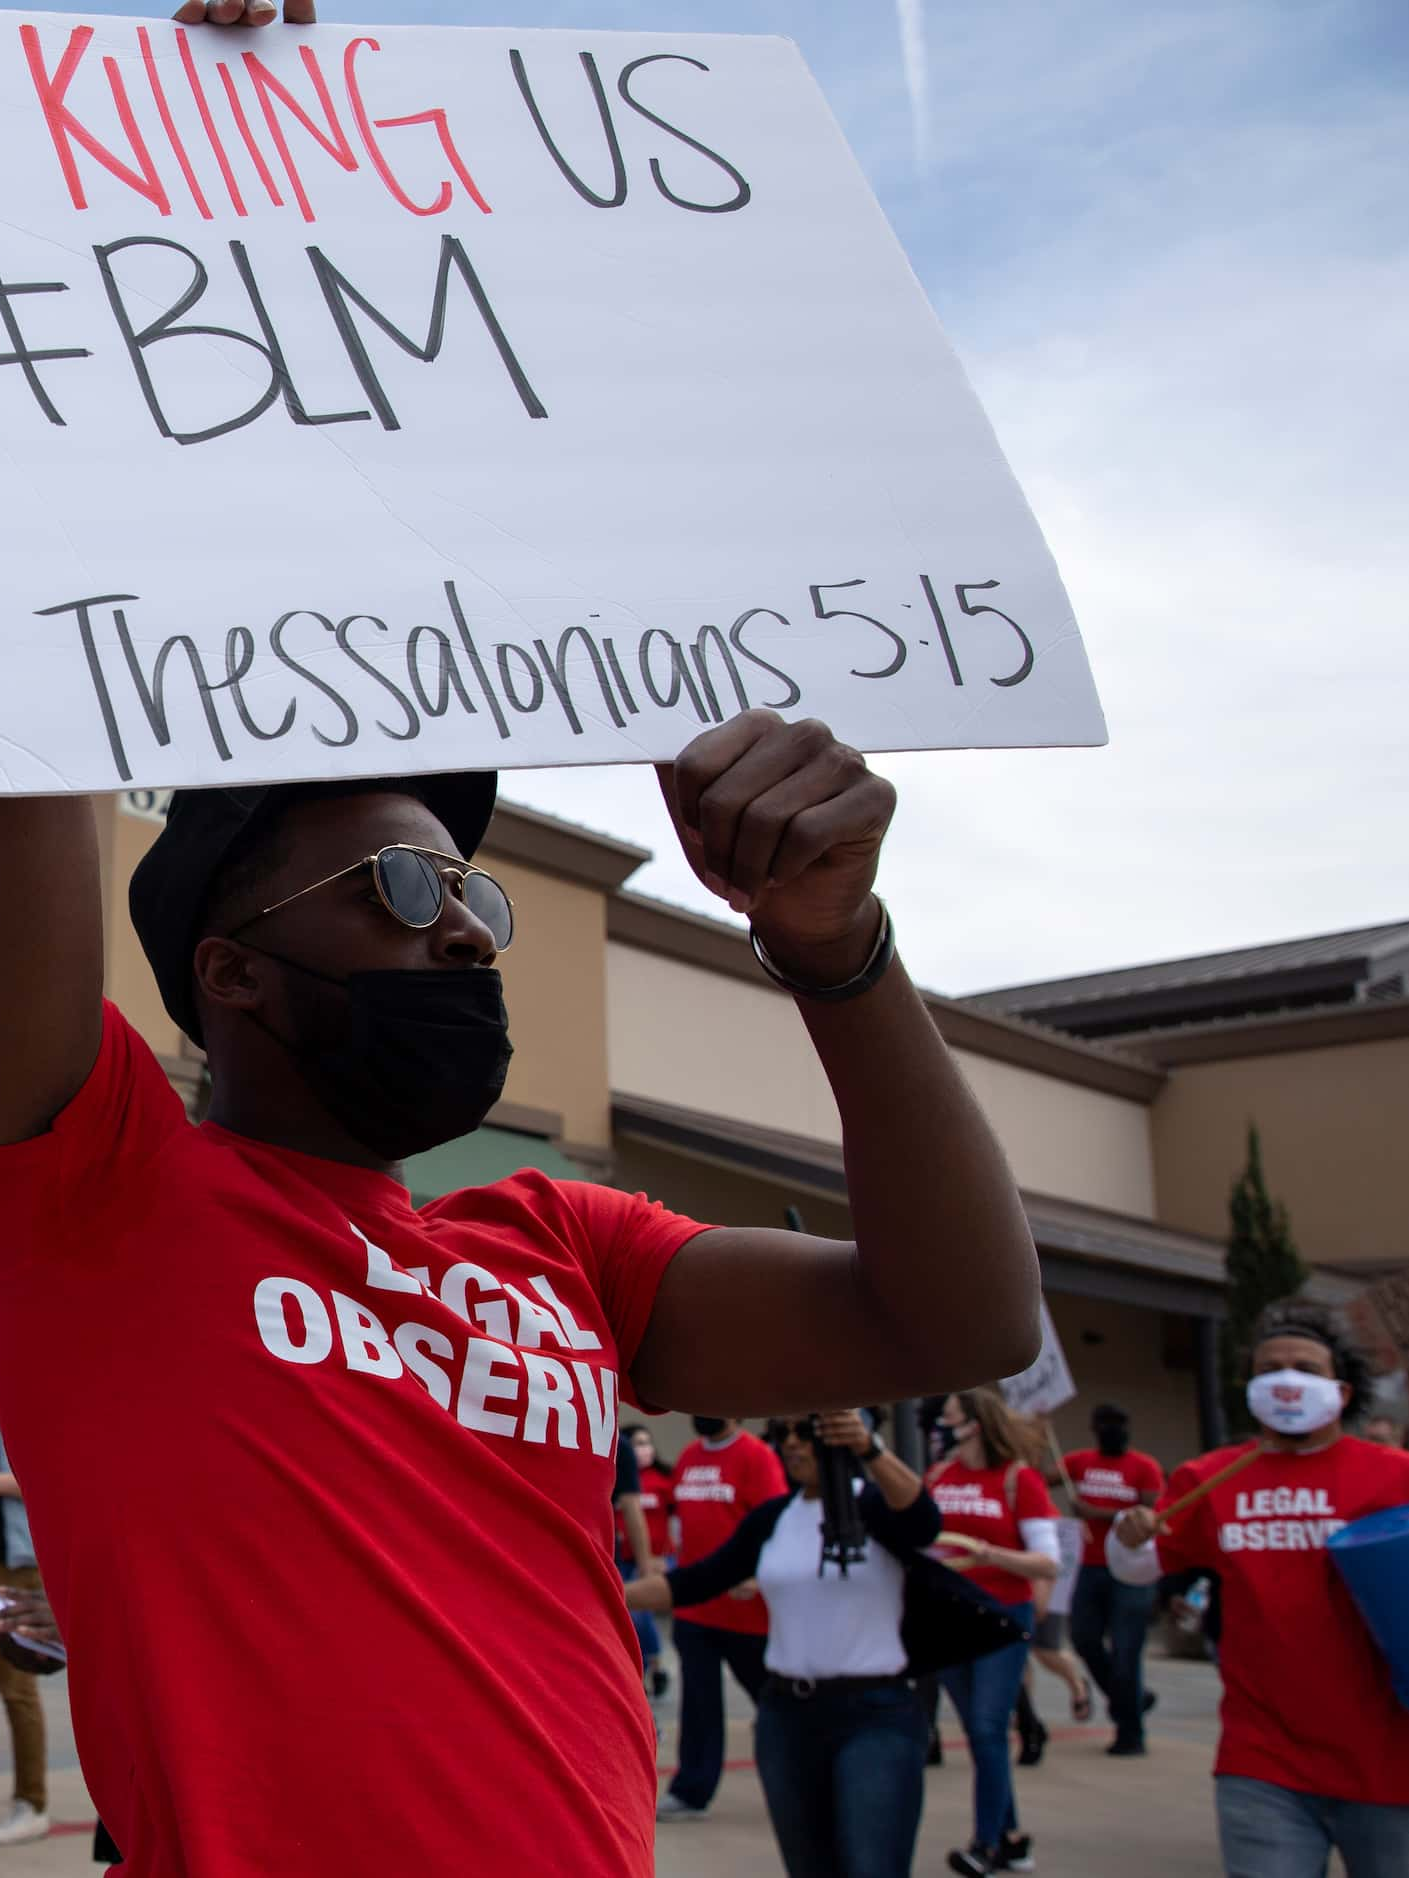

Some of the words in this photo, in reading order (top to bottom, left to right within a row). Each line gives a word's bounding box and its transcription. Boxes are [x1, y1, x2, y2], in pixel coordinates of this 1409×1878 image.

[509, 49, 752, 213] US
[33, 580, 801, 781] Thessalonians
[809, 574, 1034, 687] 5:15
[349, 1221, 602, 1352] LGAL
[1236, 1486, 1335, 1519] LEGAL
